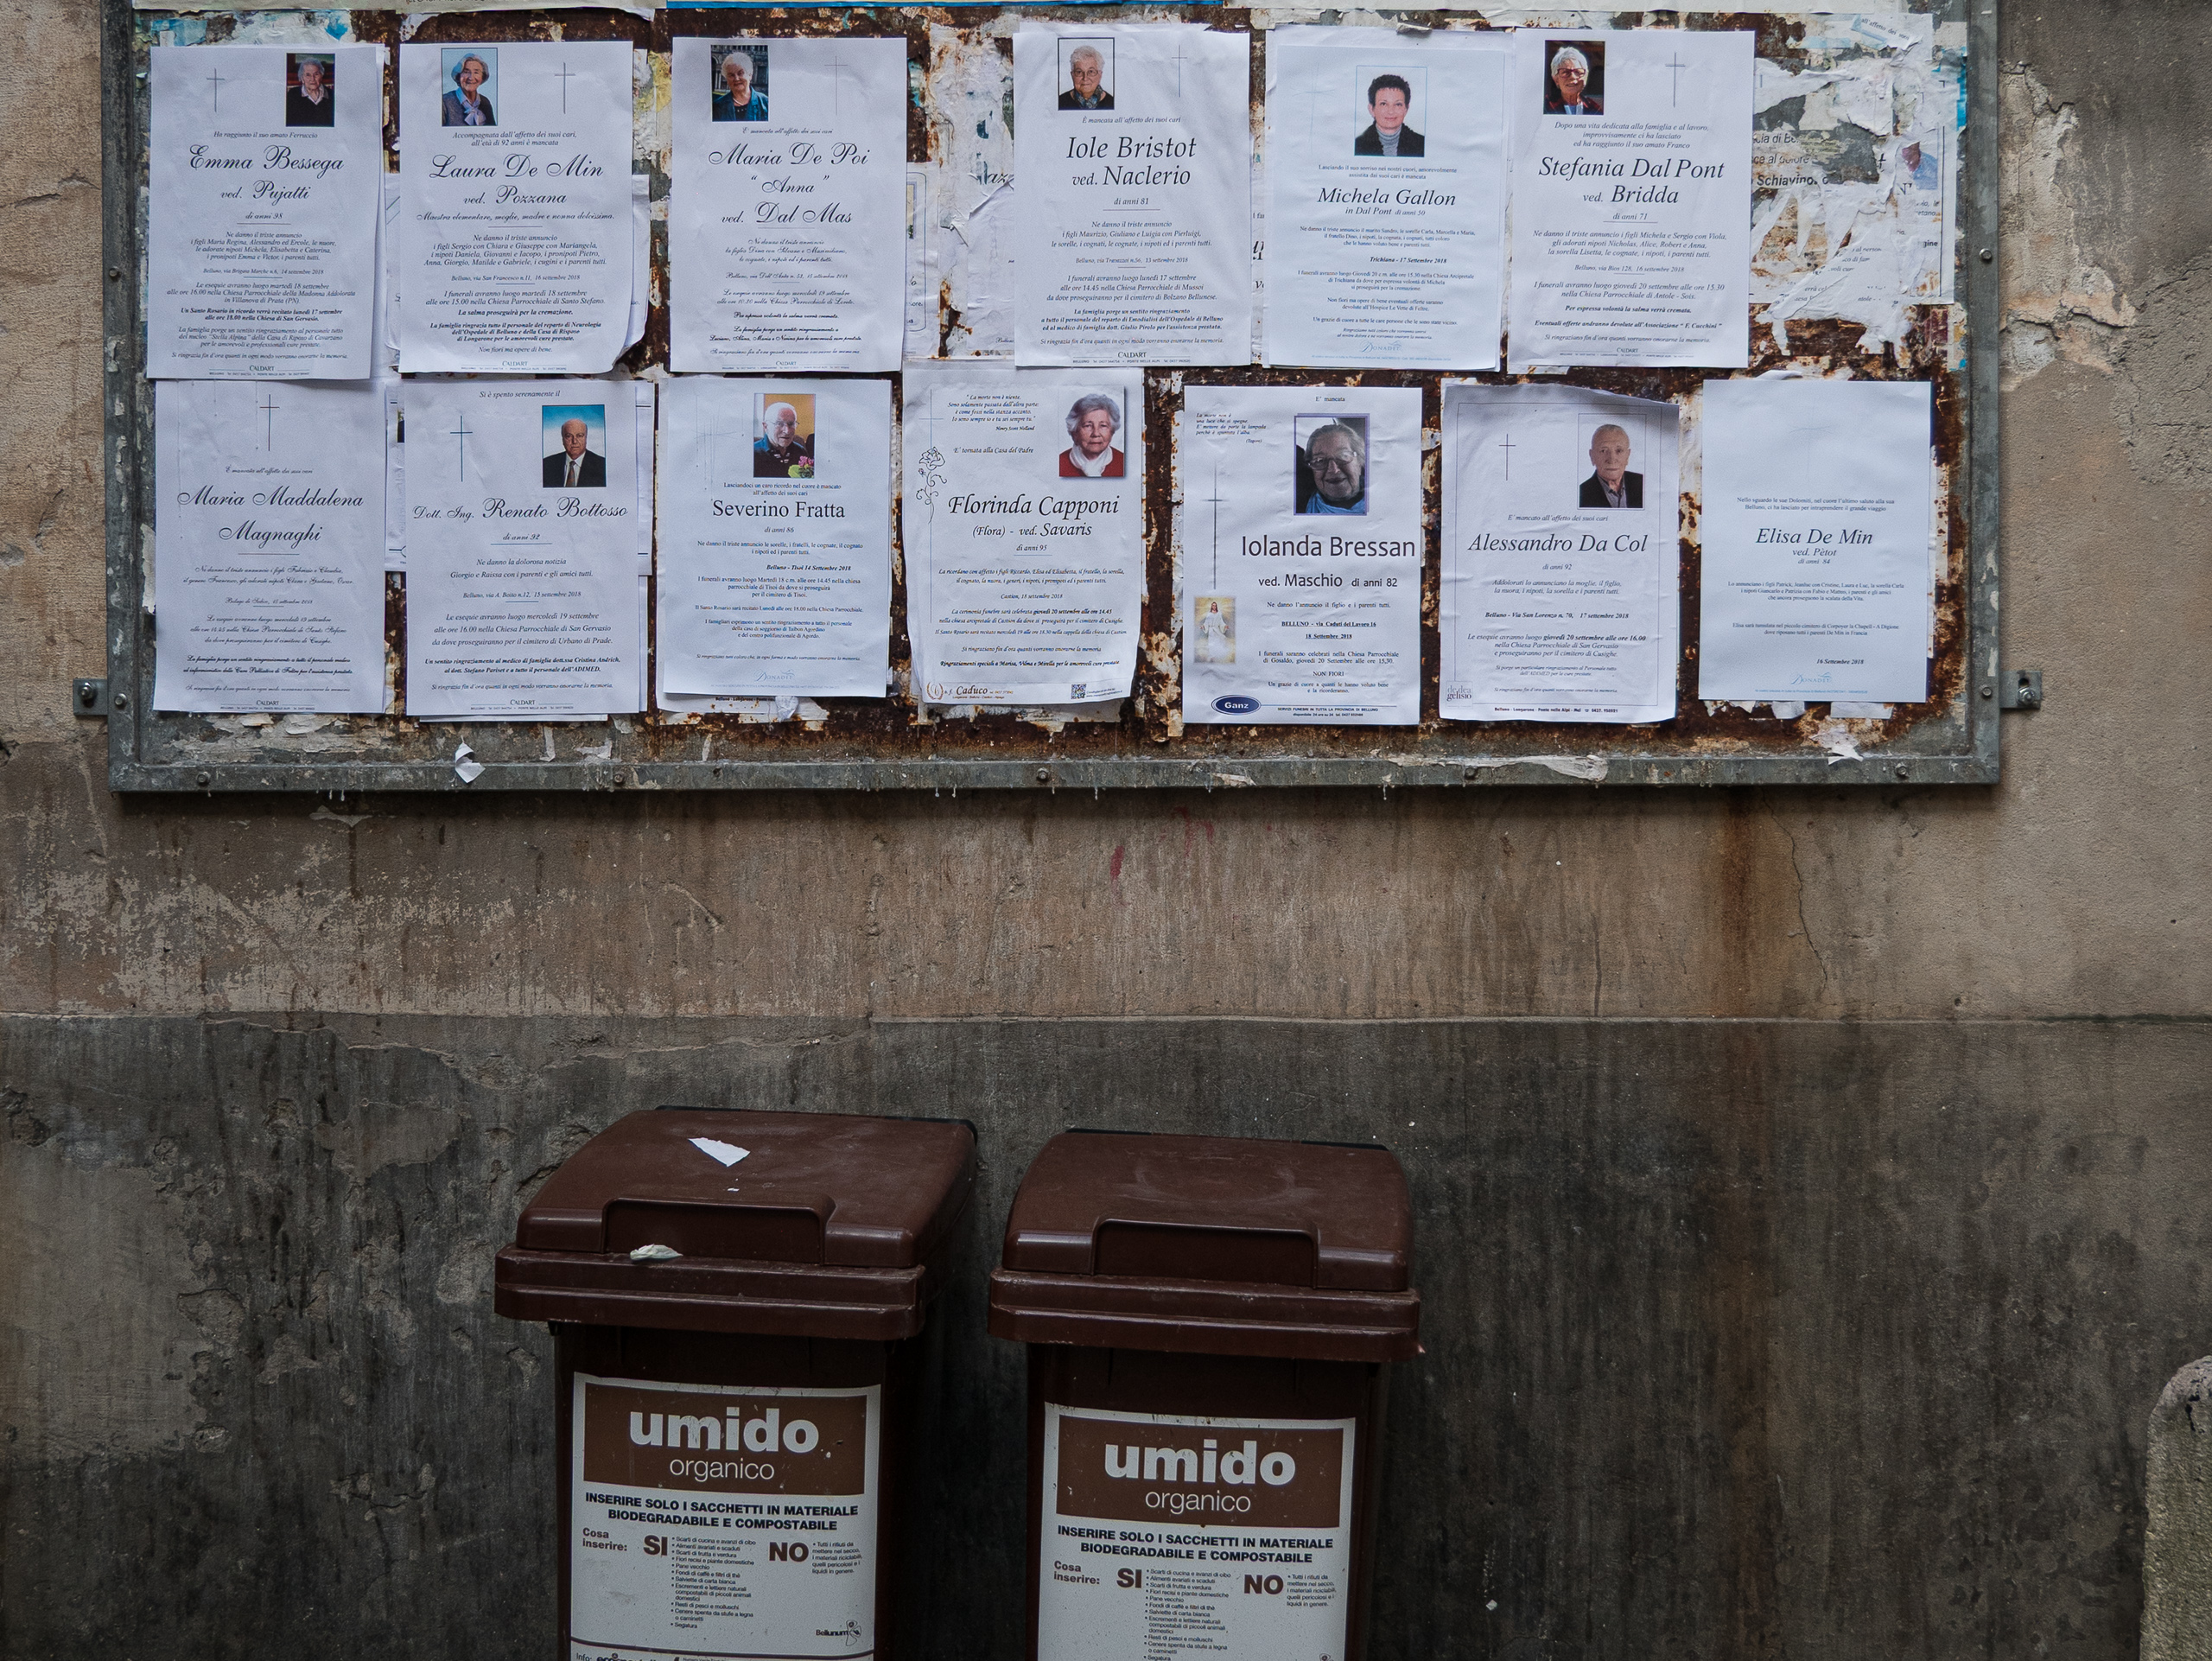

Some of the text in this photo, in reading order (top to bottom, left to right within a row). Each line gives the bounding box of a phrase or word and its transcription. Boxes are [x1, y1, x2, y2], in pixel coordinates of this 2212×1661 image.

[709, 143, 868, 164] Maria De Poi
[1066, 137, 1196, 158] Iole Bristot
[190, 144, 344, 179] Emma Bessega
[429, 154, 603, 178] Laura De Min
[1539, 157, 1724, 181] Stefania Dal Pont
[1072, 165, 1190, 185] ved. Naclerio
[221, 180, 311, 206] ved. Pujatti
[464, 185, 567, 204] ved. Pozzana
[1318, 188, 1455, 205] Michela Gallon
[1584, 185, 1678, 203] ved. Bridda
[722, 202, 851, 223] ved. Dal Mas
[177, 485, 363, 506] Maria Maddalena
[414, 497, 627, 523] Dott. Ing. Renato Bottosso
[714, 500, 845, 518] Severino Fratta
[949, 493, 1119, 520] Florinda Capponi
[219, 520, 322, 549] Magnaghi
[973, 523, 1092, 538] (Flora) ved. Savaris
[1756, 528, 1872, 544] Elisa De Min
[1243, 535, 1414, 557] Iolanda Bressan
[1468, 533, 1648, 551] Alessandro Da Col
[1259, 573, 1397, 587] ved. Maschio di anni 82
[957, 685, 988, 695] Caduco
[630, 1407, 818, 1453] umido
[671, 1458, 774, 1482] organico
[1105, 1439, 1295, 1485] umido
[586, 1492, 858, 1516] INSERIRE SOLO I SACCHETTI IN MATERIALE
[1146, 1490, 1250, 1514] organico
[608, 1507, 837, 1531] BIODEGRADABILE E COMPOSTABILE
[583, 1528, 608, 1538] Cosa
[1058, 1525, 1333, 1549] INSERIRE SOLO I SACCHETTI IN MATERIALE
[582, 1538, 627, 1551] inserire:
[644, 1535, 667, 1557] SI
[769, 1542, 809, 1562] NO
[1081, 1543, 1313, 1562] BIODEGRADABILE E COMPOSTABILE
[1054, 1561, 1081, 1572] Cosa
[1054, 1571, 1099, 1584] inserire:
[1116, 1568, 1141, 1588] SI
[1244, 1575, 1283, 1594] NO
[816, 1627, 849, 1637] Bellunum
